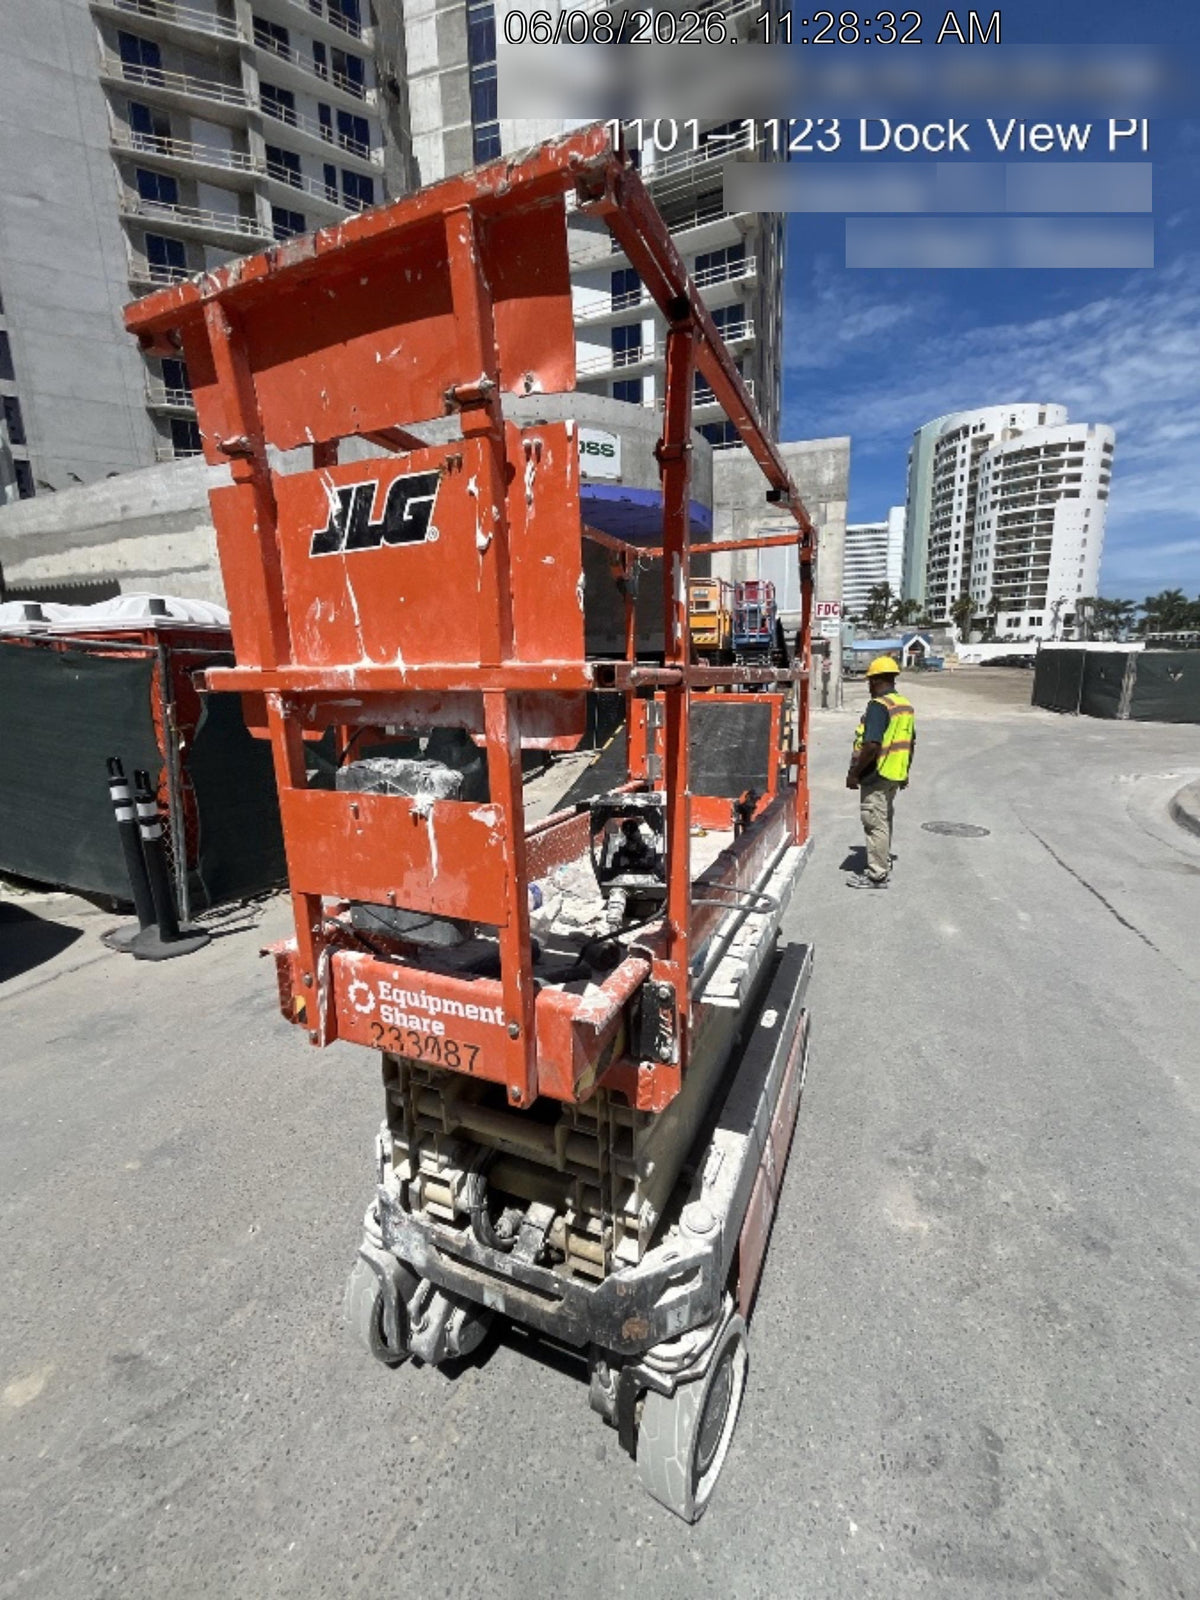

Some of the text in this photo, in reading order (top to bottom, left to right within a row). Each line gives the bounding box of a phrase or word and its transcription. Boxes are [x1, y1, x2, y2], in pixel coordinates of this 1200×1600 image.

[309, 468, 441, 558] JLG
[817, 603, 841, 616] FDC
[377, 980, 506, 1027] Equipment
[379, 1004, 446, 1036] Share
